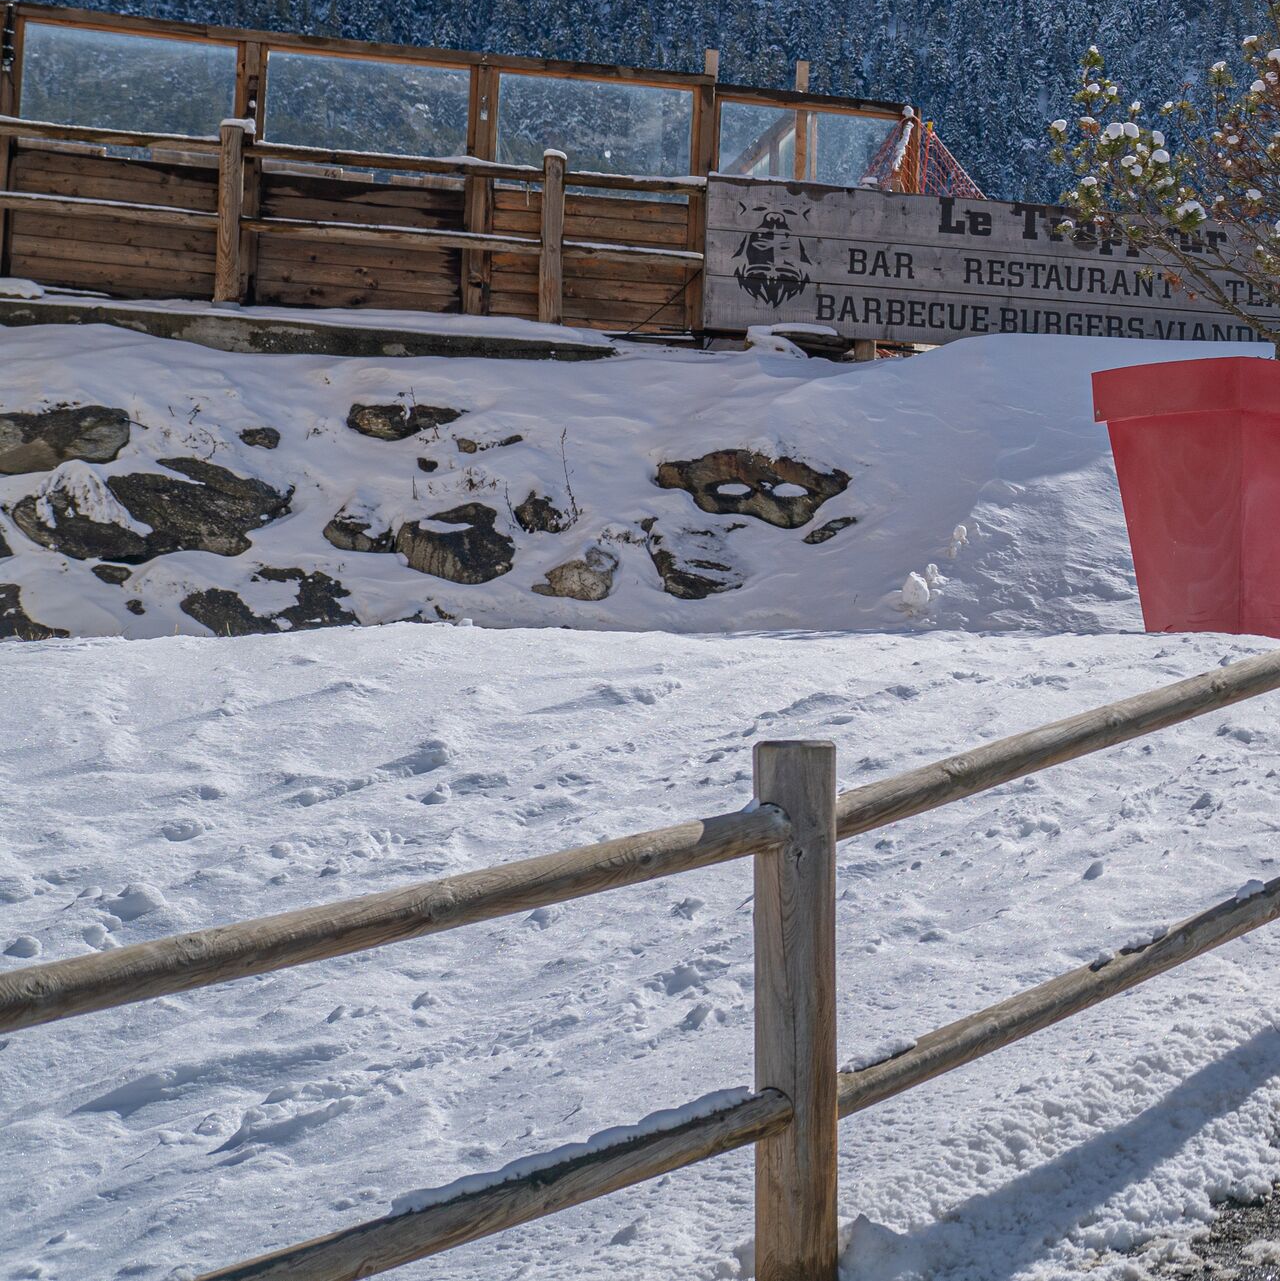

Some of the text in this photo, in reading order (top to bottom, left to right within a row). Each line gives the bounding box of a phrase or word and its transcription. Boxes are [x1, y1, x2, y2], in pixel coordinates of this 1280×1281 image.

[938, 197, 992, 236] Le
[848, 248, 914, 279] BAR
[964, 257, 1172, 298] RESTAURANT
